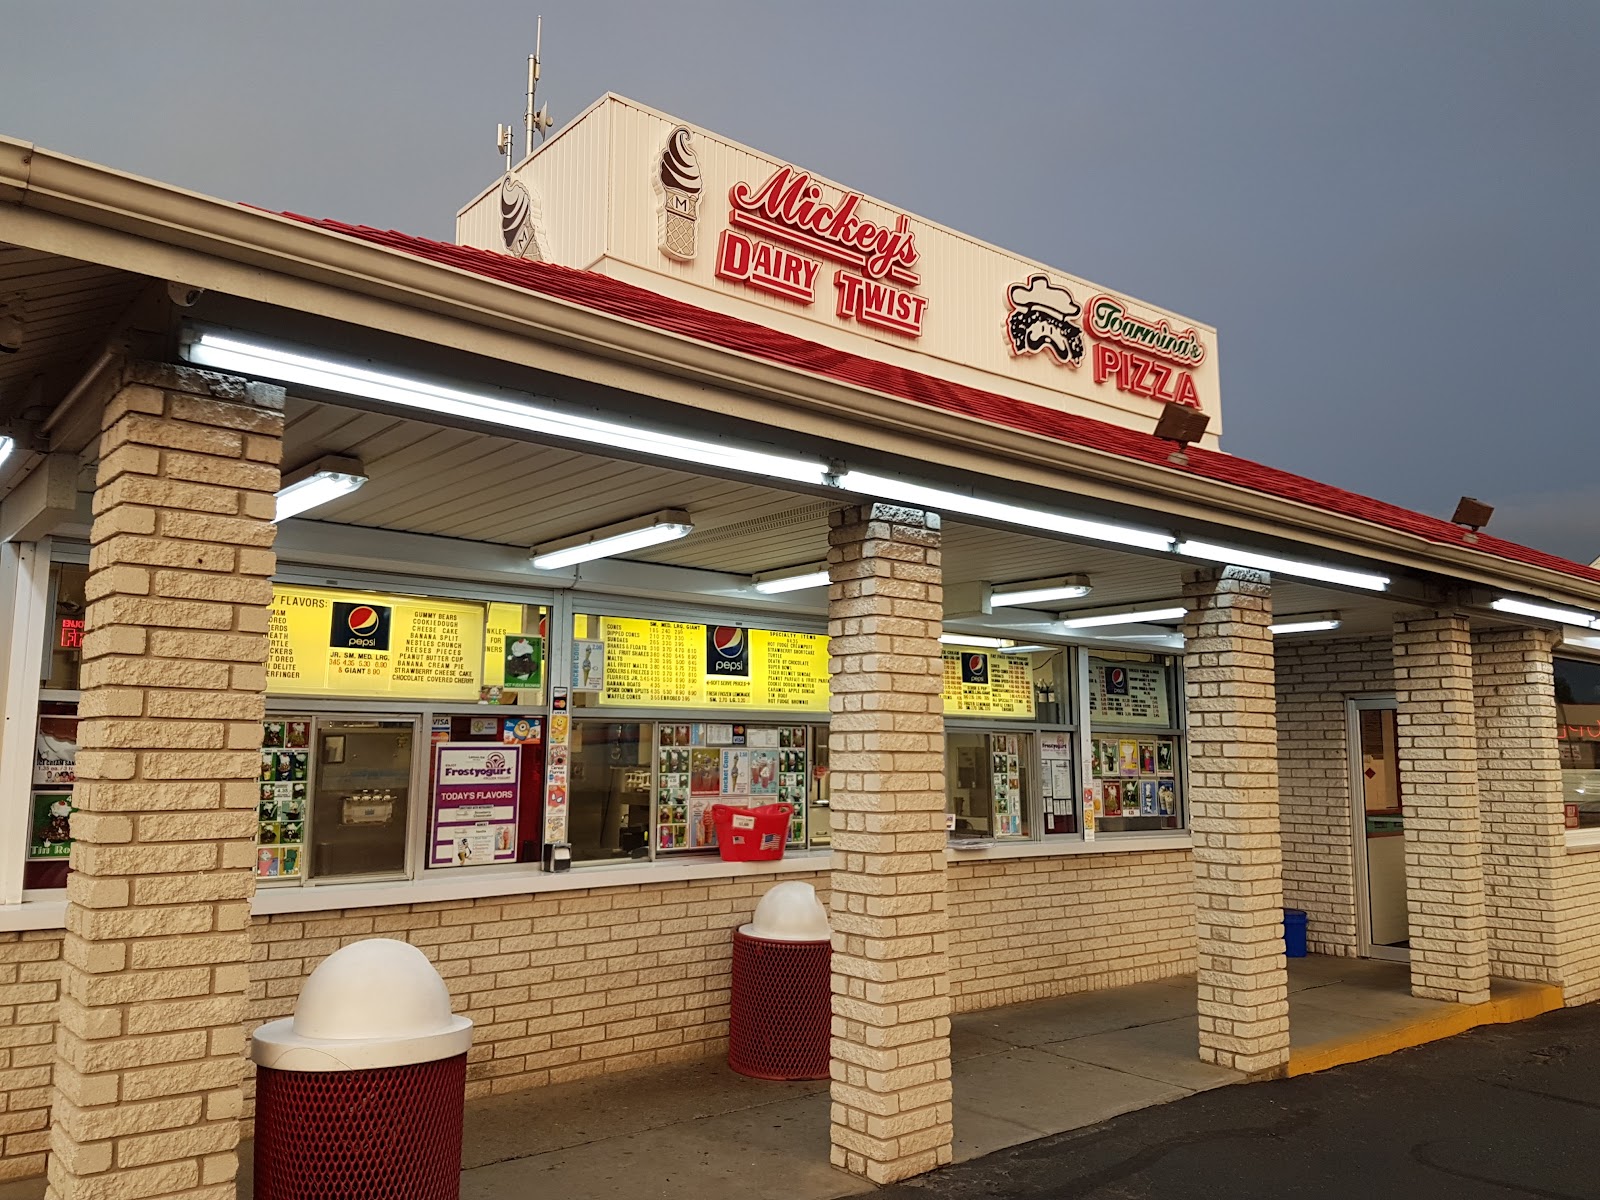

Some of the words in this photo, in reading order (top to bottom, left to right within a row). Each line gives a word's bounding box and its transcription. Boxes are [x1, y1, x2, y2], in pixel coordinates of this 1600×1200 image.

[676, 196, 686, 212] M
[729, 165, 920, 278] Mickey's
[716, 229, 823, 293] DAIRY
[835, 270, 929, 326] TWIST
[1090, 299, 1203, 362] Toarmina's
[1094, 344, 1203, 411] PIZZA
[281, 596, 328, 608] FLAVORS:
[349, 638, 375, 647] pepsi
[406, 639, 435, 647] NESTLES
[405, 646, 432, 654] REESES
[394, 667, 432, 675] STRAWBERRY
[716, 661, 743, 672] pepsi
[392, 674, 424, 682] CHOCOLATE
[445, 767, 511, 777] Frostyogurt
[442, 792, 475, 800] TODAY'S
[477, 791, 513, 799] FLAVORS
[31, 845, 50, 854] Tin
